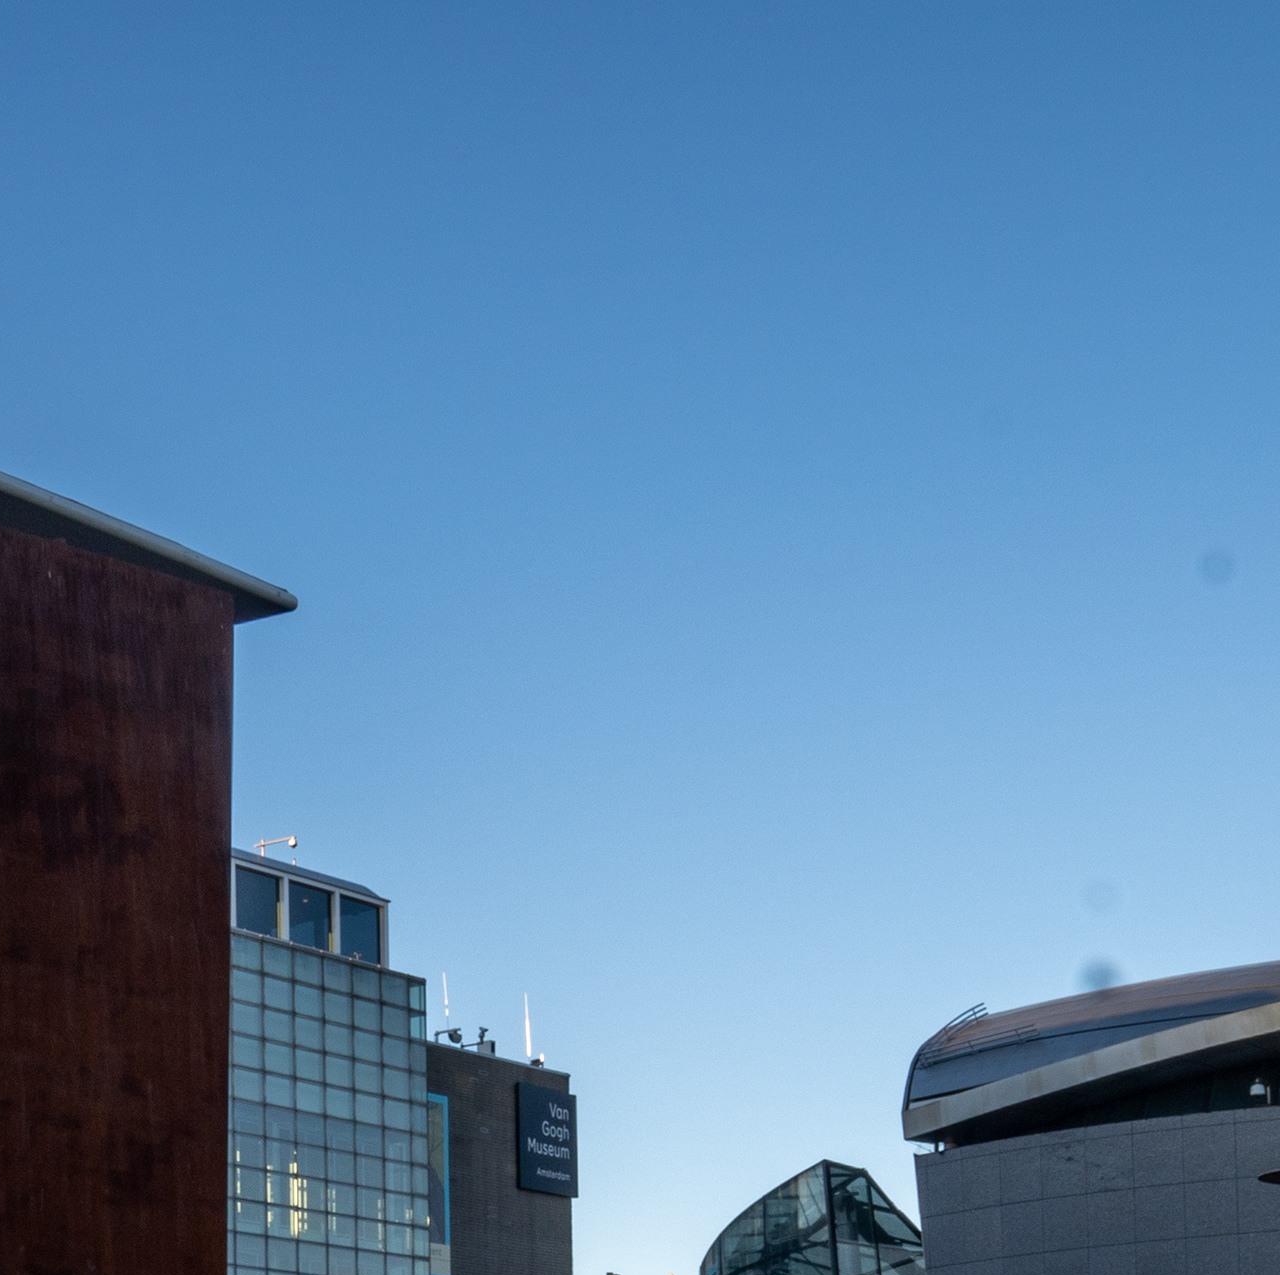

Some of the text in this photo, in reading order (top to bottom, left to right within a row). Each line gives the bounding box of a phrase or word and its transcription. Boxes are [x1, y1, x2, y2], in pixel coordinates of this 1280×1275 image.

[549, 1102, 569, 1121] Van
[541, 1120, 570, 1142] Gogh
[527, 1136, 570, 1159] Museum
[536, 1167, 570, 1181] Amsterdam
